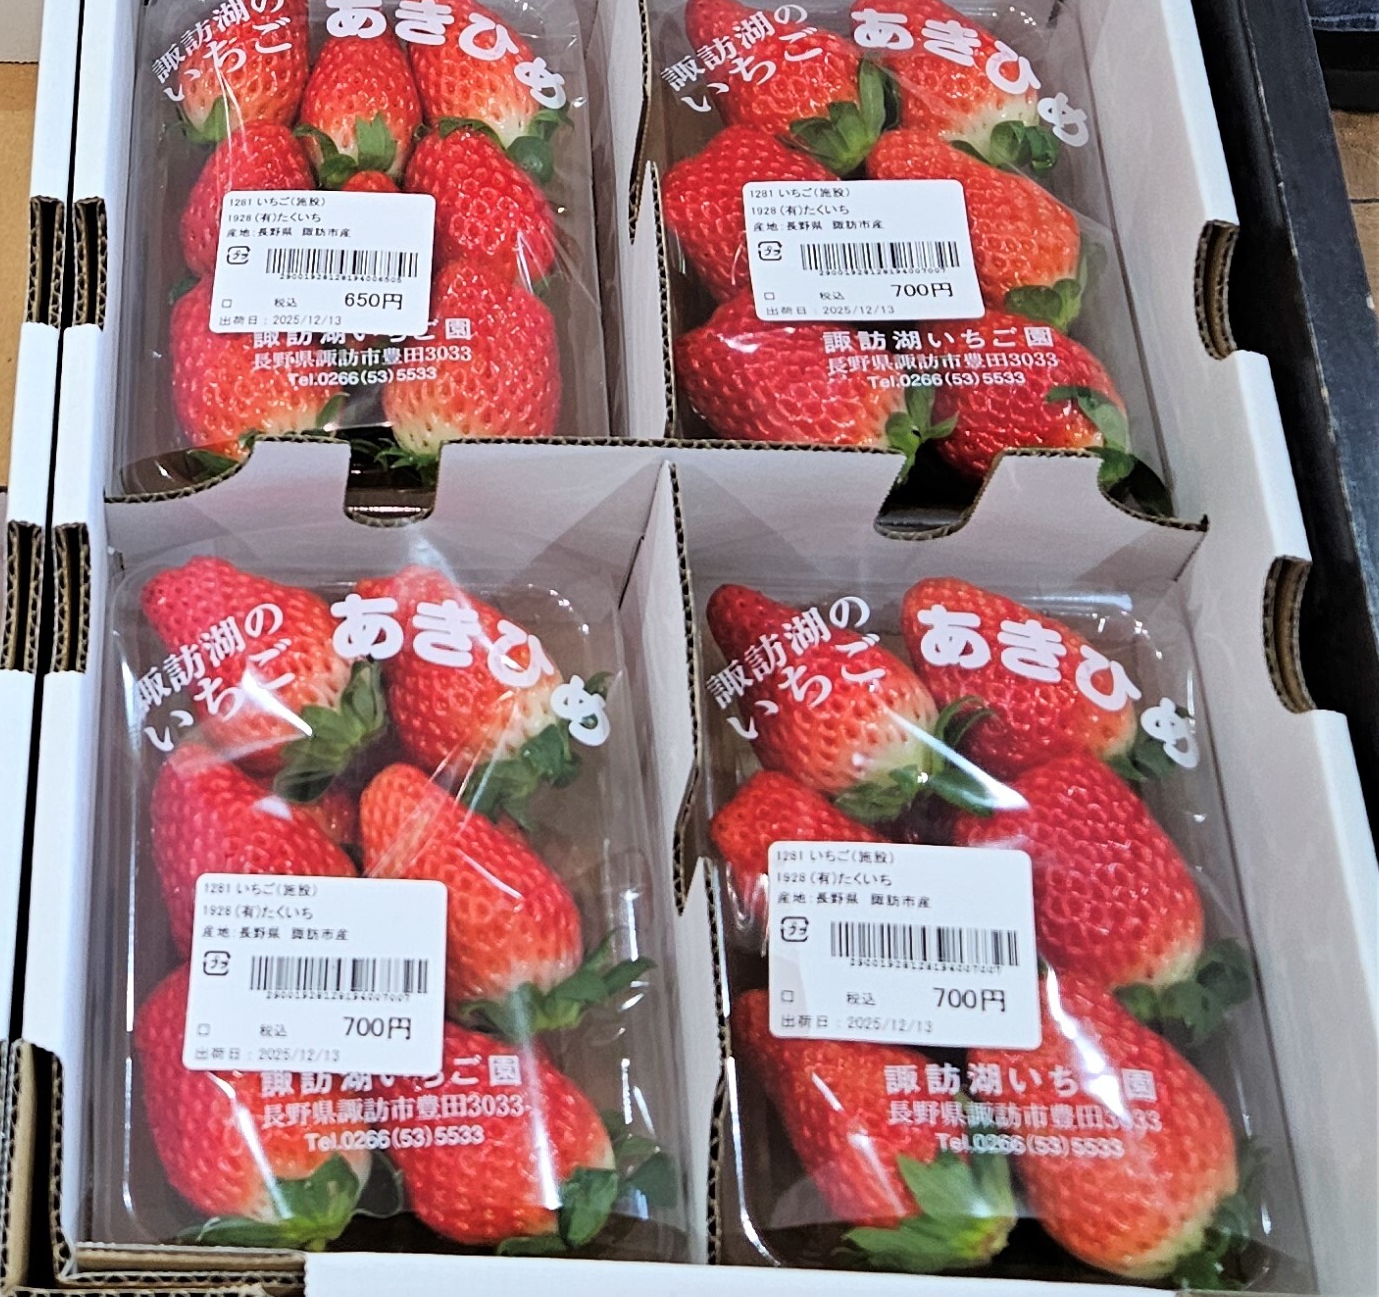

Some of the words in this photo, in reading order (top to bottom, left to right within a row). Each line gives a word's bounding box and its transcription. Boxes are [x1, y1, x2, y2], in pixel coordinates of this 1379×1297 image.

[660, 3, 808, 94] 諏訪湖の
[850, 7, 1090, 147] あきひめ
[750, 189, 773, 198] 1281
[779, 187, 850, 198] いちご(施設)
[257, 197, 326, 207] いちご(施設)
[752, 206, 776, 215] 1928
[779, 205, 849, 215] (有)たくいち
[255, 213, 321, 222] (有)たくいち
[820, 292, 845, 300] 税込
[891, 283, 953, 297] 700円
[274, 298, 297, 307] 税込
[345, 293, 402, 310] 650円
[824, 306, 895, 315] 2025/12/13
[273, 316, 341, 325] 2025/12/13
[823, 326, 1054, 354] 諏訪湖いちご園
[253, 346, 471, 370] 長野県諏訪市豊田3033
[827, 351, 1059, 376] 長野県諏訪市豊田3033
[705, 594, 870, 717] 諏訪湖の
[330, 593, 610, 747] あきひめ
[919, 603, 1199, 769] あきひめ
[776, 852, 802, 861] 1281
[810, 851, 894, 863] いちご(施設)
[777, 873, 805, 882] 1928
[810, 872, 892, 886] (有)たくいち
[204, 884, 230, 894] 1281
[236, 883, 318, 897] いちご(施設)
[203, 906, 231, 916] 1928
[235, 905, 313, 919] (有)たくいち
[292, 928, 349, 940] 諏訪市産
[847, 992, 876, 1006] 税込
[933, 987, 1005, 1012] 700円
[260, 1025, 287, 1037] 税込
[343, 1017, 411, 1039] 700円
[848, 1016, 933, 1033] 2025/12/13
[259, 1049, 340, 1062] 2025/12/13
[884, 1063, 1158, 1102] 諏訪湖いち園
[262, 1093, 525, 1129] 長野県諏訪市豊田3033
